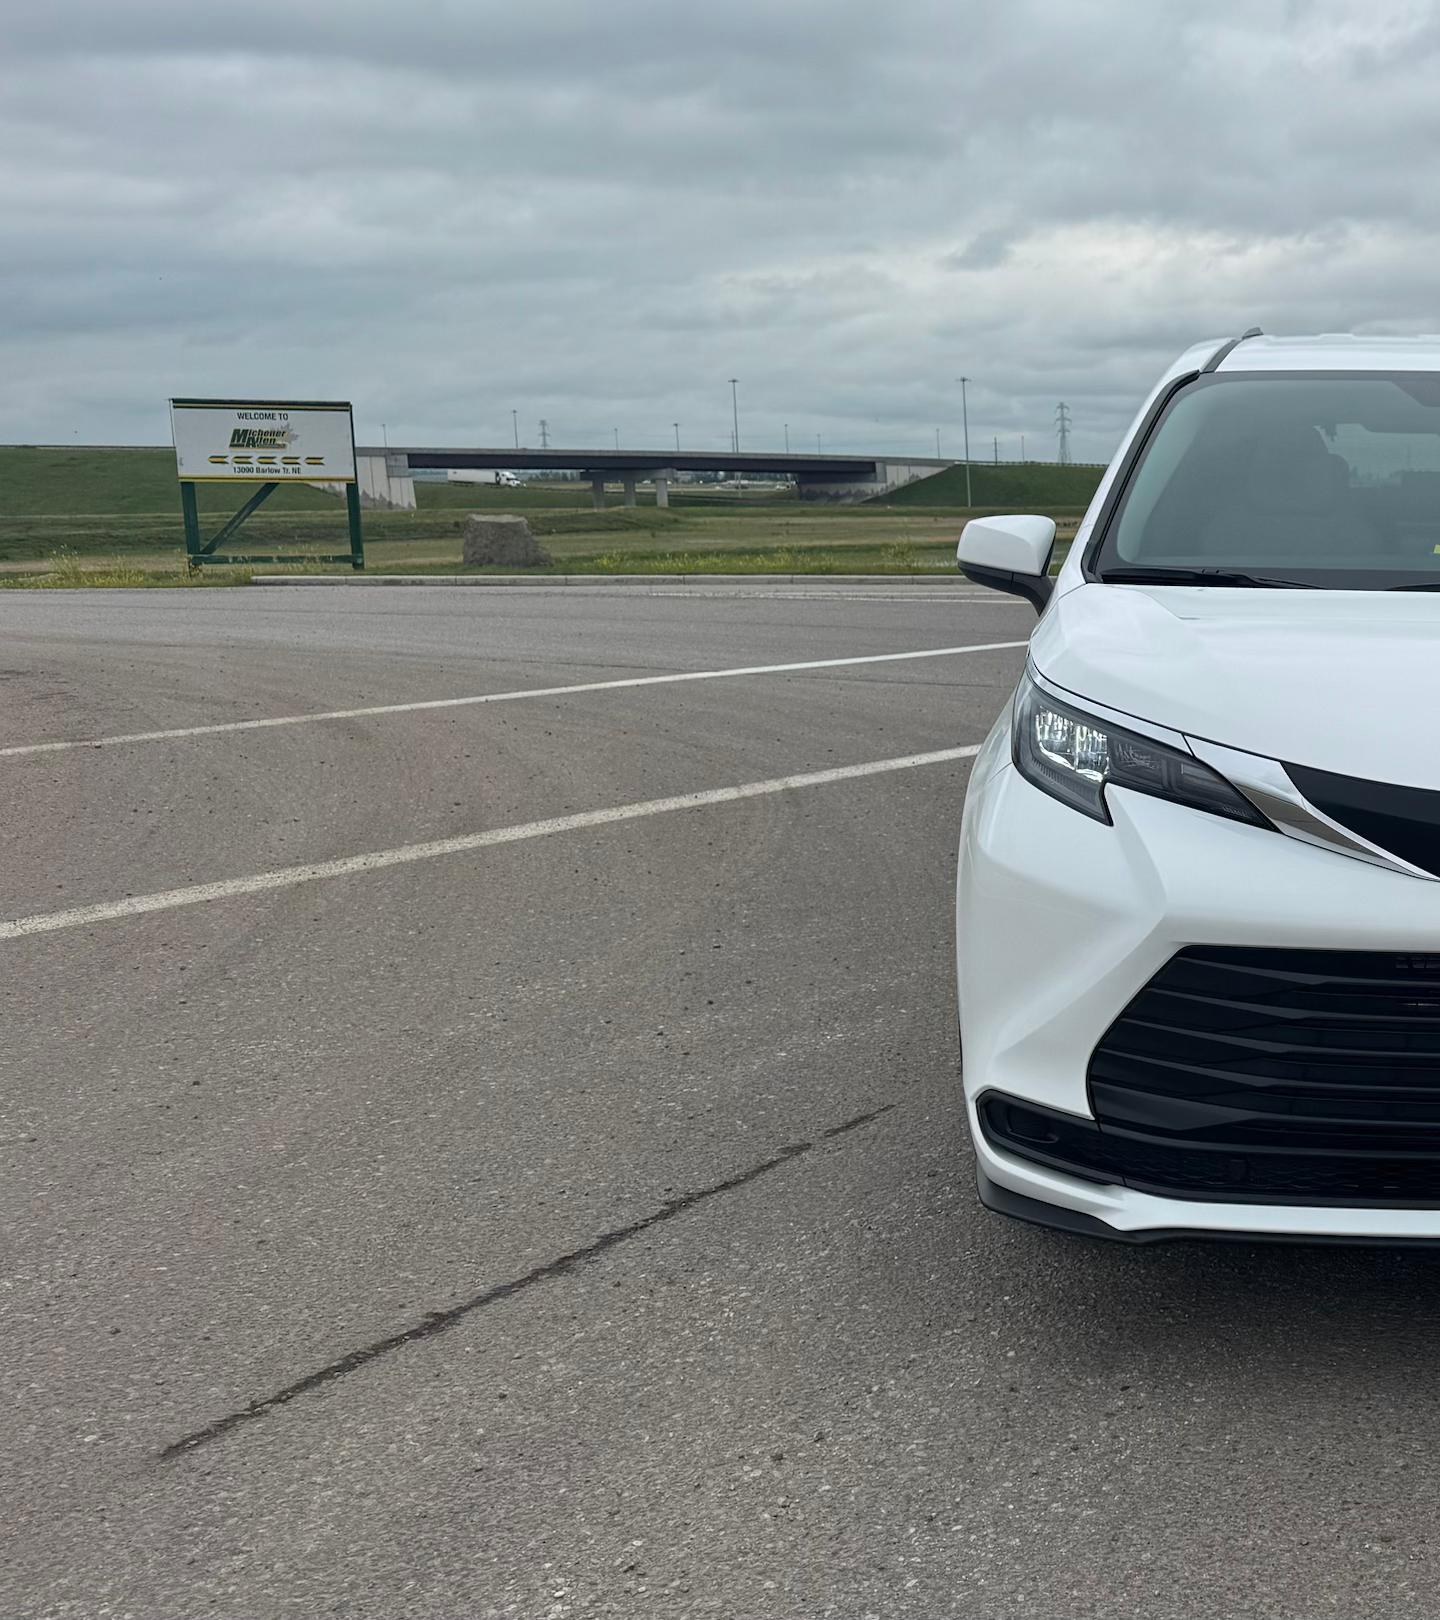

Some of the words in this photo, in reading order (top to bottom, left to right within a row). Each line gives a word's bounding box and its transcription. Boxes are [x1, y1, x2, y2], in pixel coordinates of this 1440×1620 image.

[237, 412, 276, 420] WELCOME
[279, 412, 289, 421] TO
[230, 428, 287, 443] Michener
[245, 437, 277, 448] Allen
[256, 466, 281, 474] Barlow
